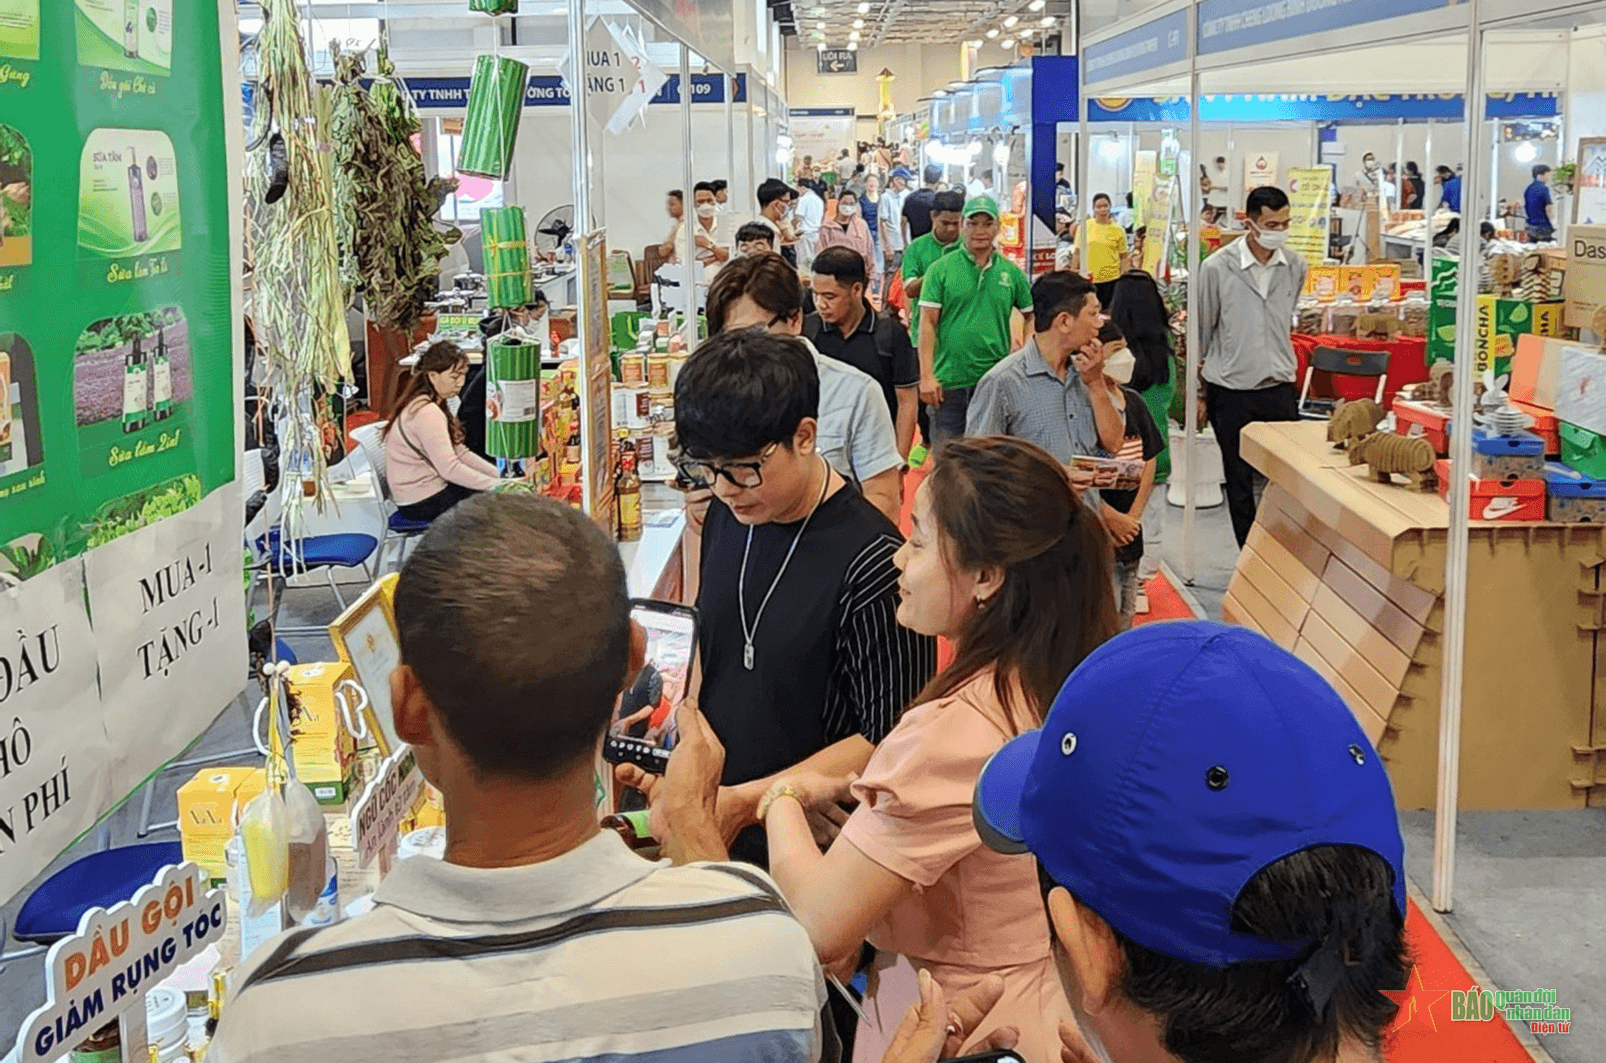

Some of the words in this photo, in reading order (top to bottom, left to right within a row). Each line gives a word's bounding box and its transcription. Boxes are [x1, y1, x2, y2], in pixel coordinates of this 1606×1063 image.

[614, 51, 621, 67] 1
[630, 56, 641, 71] 2
[839, 52, 853, 60] RA
[618, 77, 625, 93] 1
[638, 79, 646, 94] 1
[411, 89, 427, 100] TY
[428, 88, 463, 99] TNHH
[1477, 305, 1490, 372] BONCHA
[22, 755, 71, 834] PHÍ
[64, 918, 130, 992] DẦU
[141, 876, 194, 935] GỘI
[35, 988, 104, 1056] GIẢM
[111, 937, 177, 1003] RỤNG
[182, 902, 222, 948] TÓC
